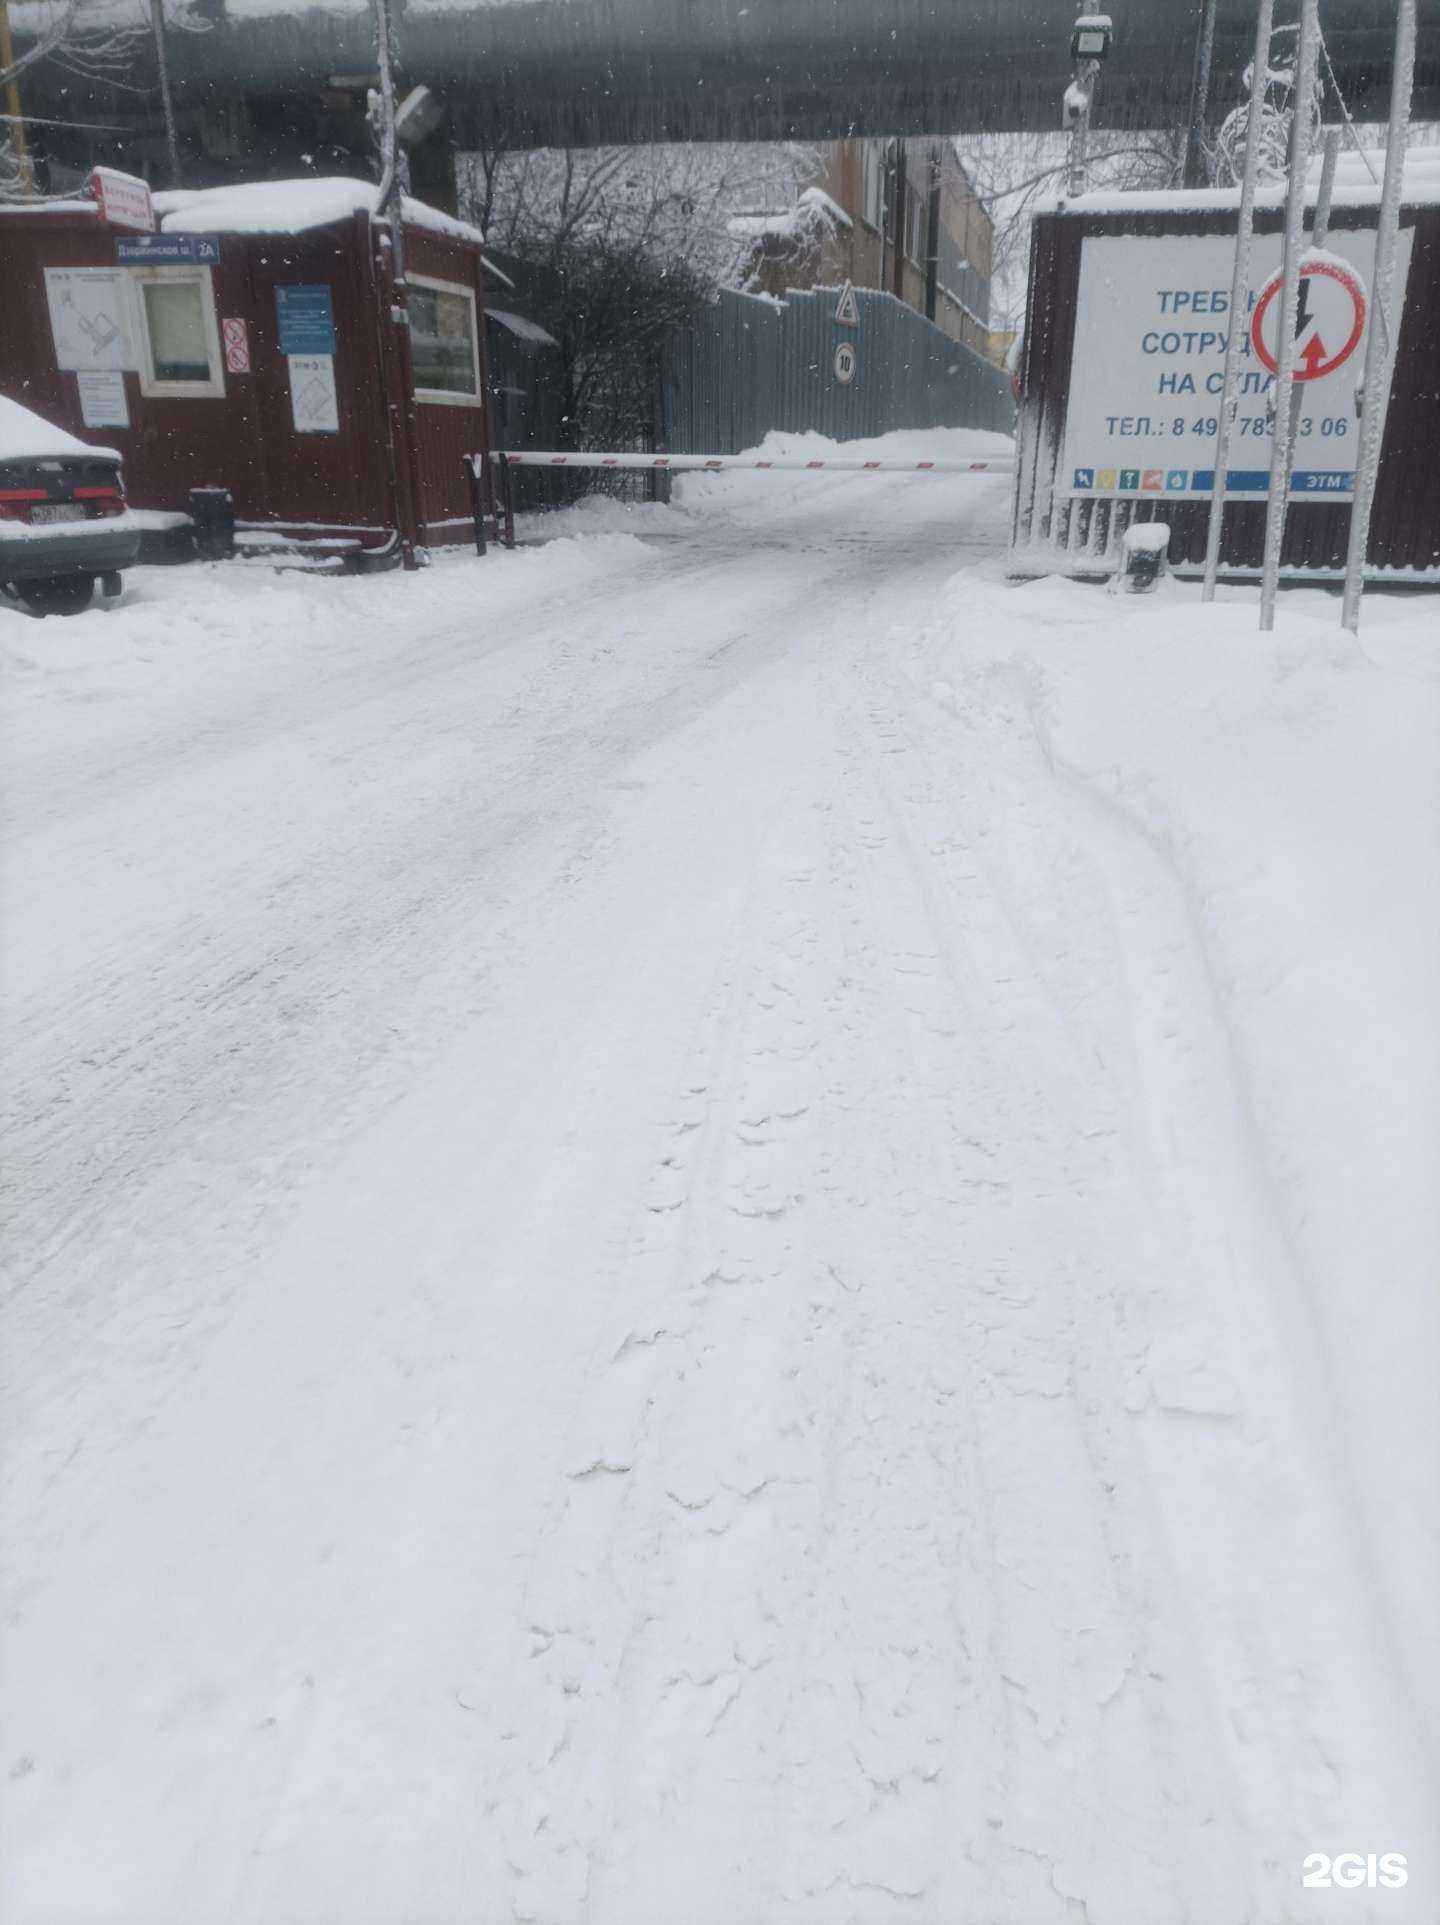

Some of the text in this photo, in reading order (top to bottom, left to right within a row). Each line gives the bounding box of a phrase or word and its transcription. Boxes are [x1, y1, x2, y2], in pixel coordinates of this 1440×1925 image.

[839, 355, 851, 372] 10
[1159, 373, 1196, 394] НА
[1105, 417, 1164, 436] ТЕЛ.:
[1172, 418, 1185, 436] 8
[1192, 418, 1218, 436] 49
[1320, 418, 1348, 436] 06
[1306, 476, 1341, 488] ЭТМ
